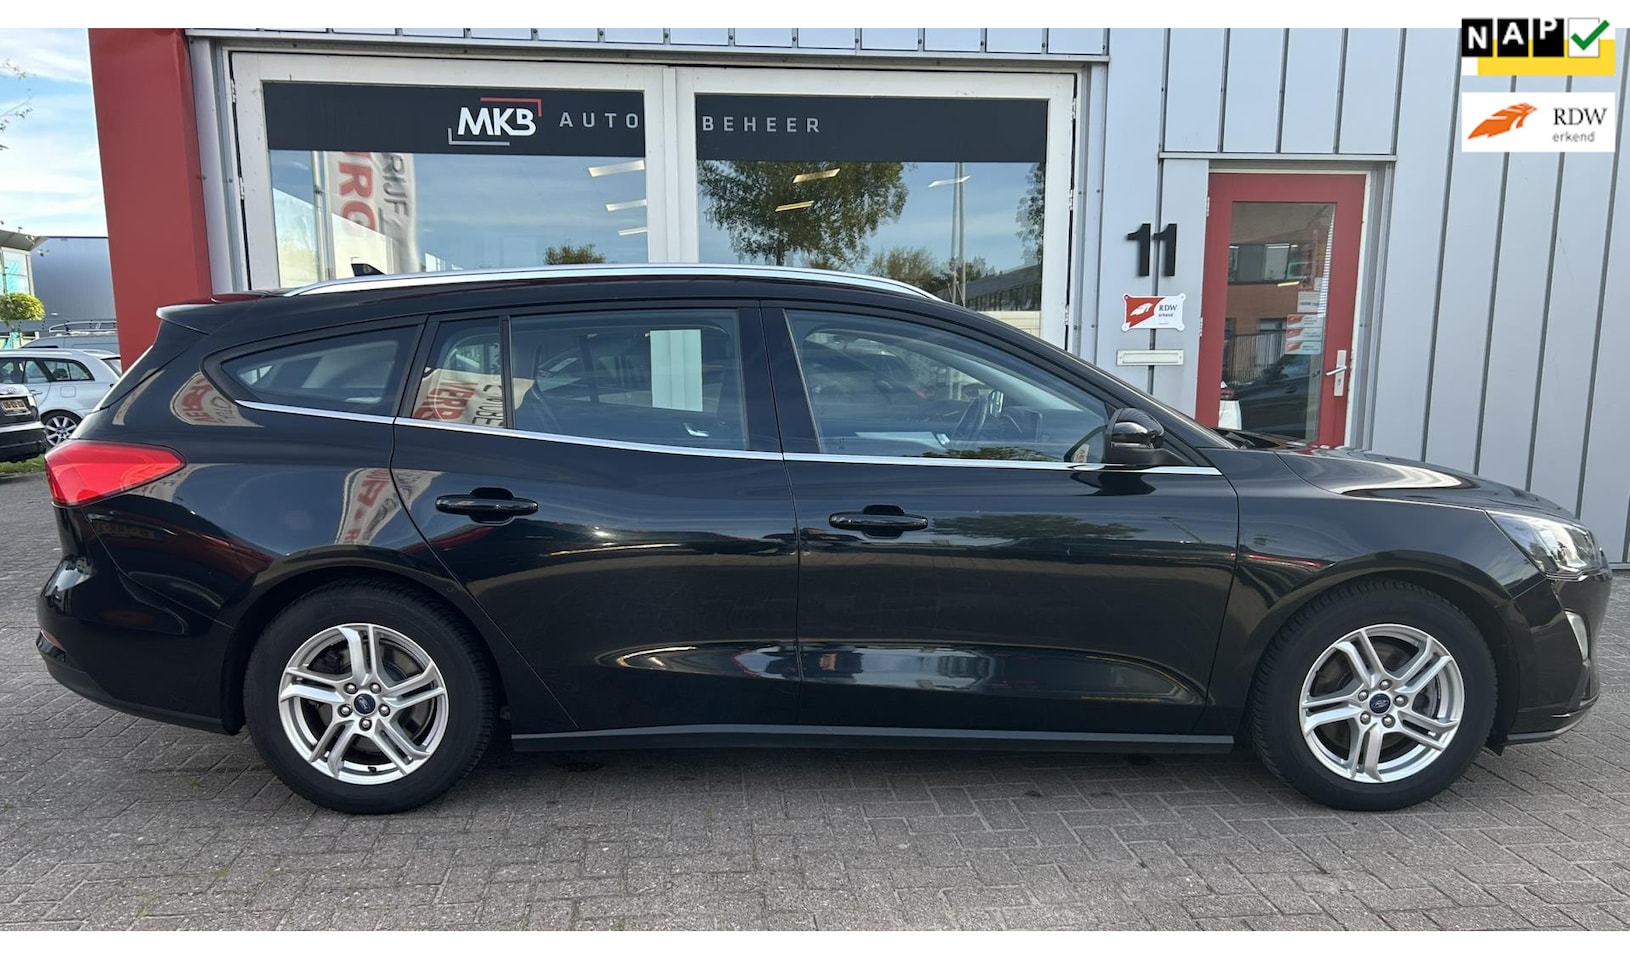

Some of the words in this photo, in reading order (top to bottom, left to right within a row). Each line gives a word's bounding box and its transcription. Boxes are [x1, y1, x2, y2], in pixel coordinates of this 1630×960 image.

[457, 107, 537, 137] MKB
[559, 112, 639, 129] AUTO
[702, 115, 820, 133] BEHEER
[1127, 223, 1177, 277] 11
